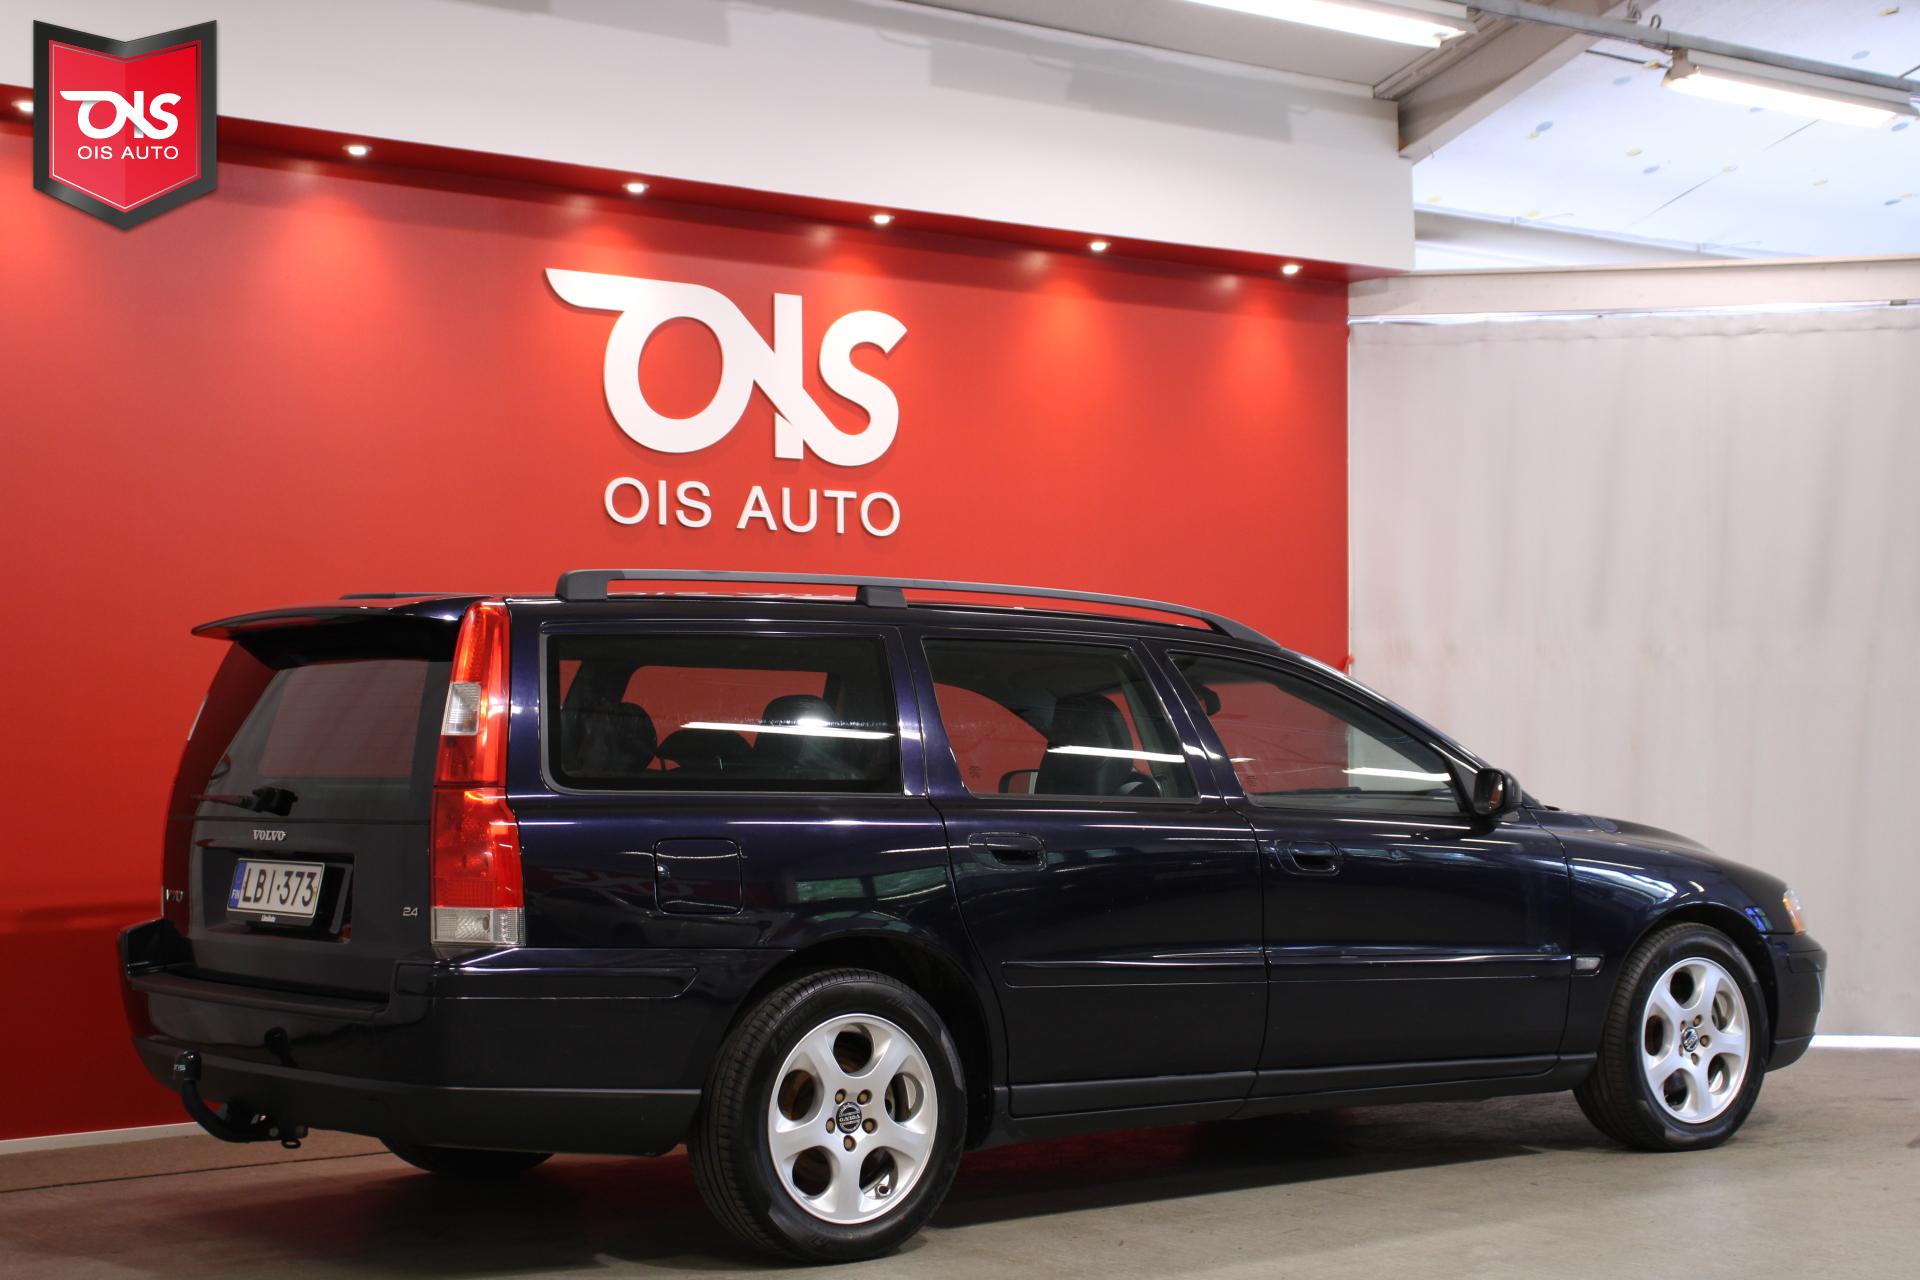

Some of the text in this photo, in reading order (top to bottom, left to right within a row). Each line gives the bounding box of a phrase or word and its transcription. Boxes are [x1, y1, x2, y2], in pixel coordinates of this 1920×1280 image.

[603, 476, 901, 537] OIS AUTO
[252, 829, 287, 841] VOLVO
[242, 867, 317, 907] LBI-373
